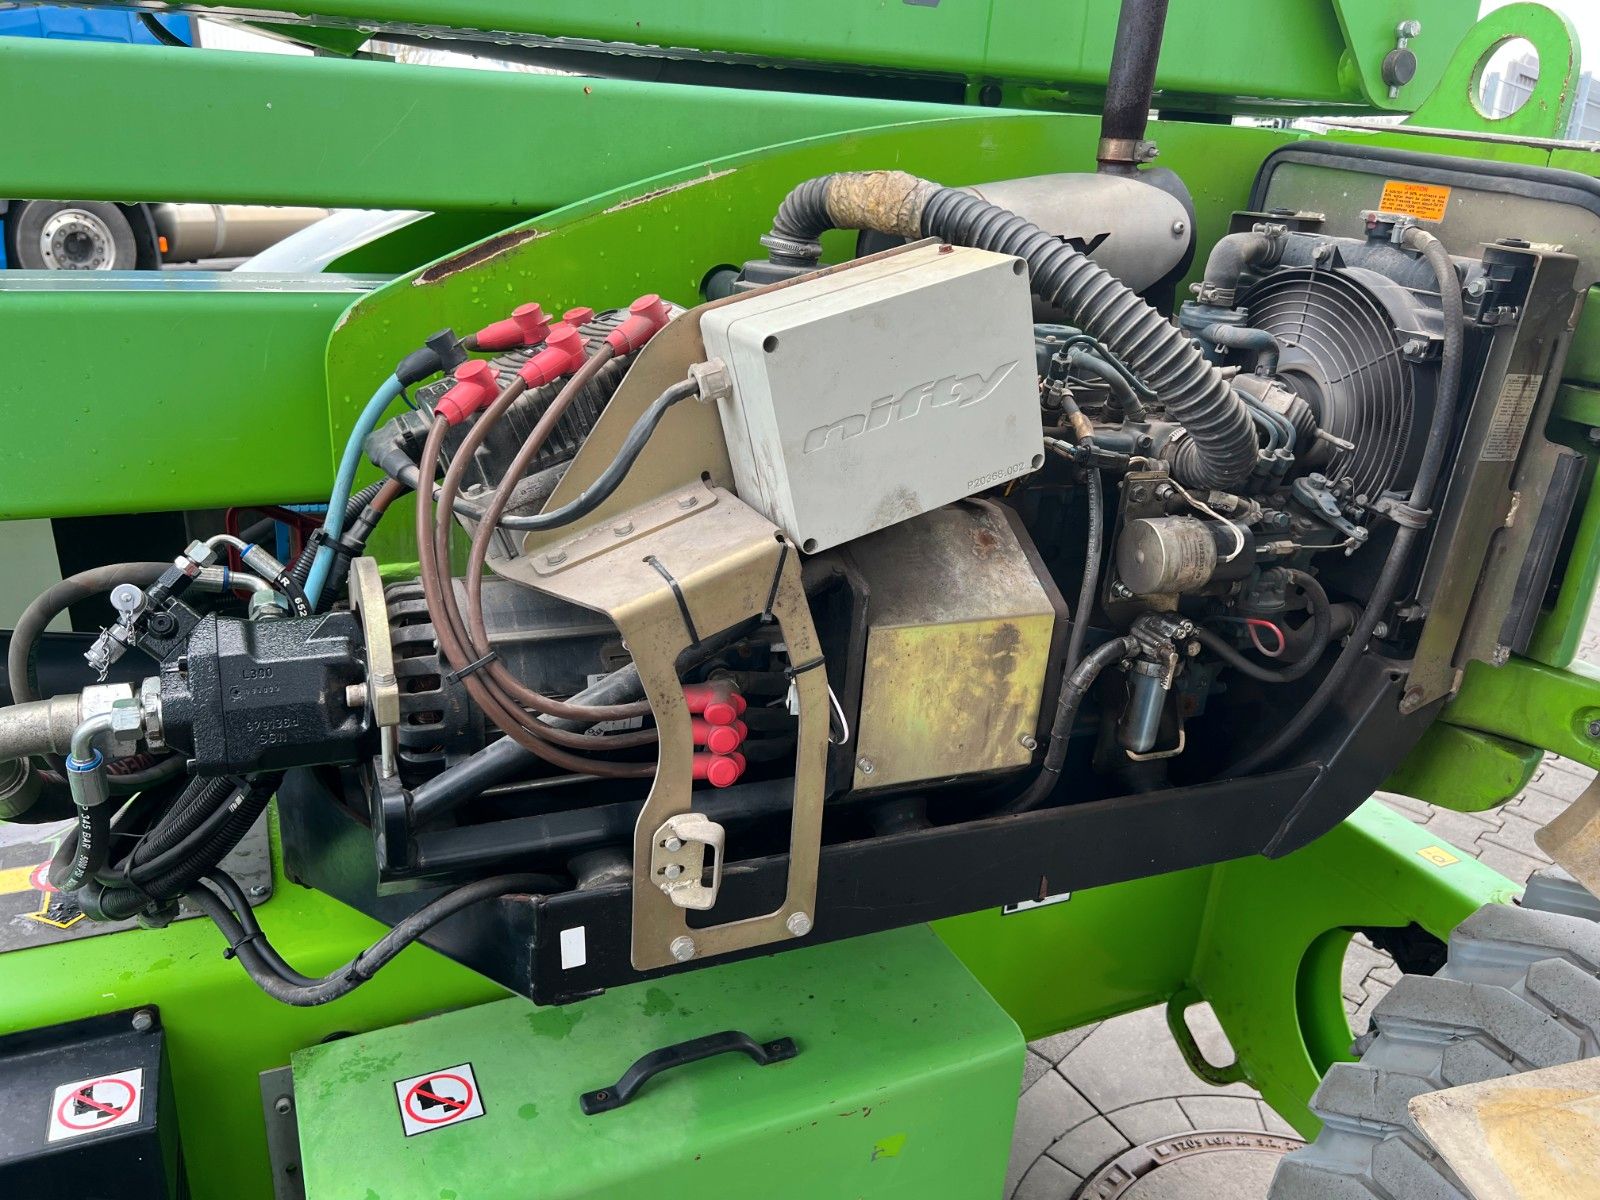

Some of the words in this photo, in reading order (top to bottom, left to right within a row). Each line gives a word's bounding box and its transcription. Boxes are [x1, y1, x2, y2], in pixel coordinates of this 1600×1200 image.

[803, 360, 1019, 455] nifty
[967, 462, 1025, 490] P20368.002
[81, 813, 91, 831] 345
[81, 831, 92, 849] BAR
